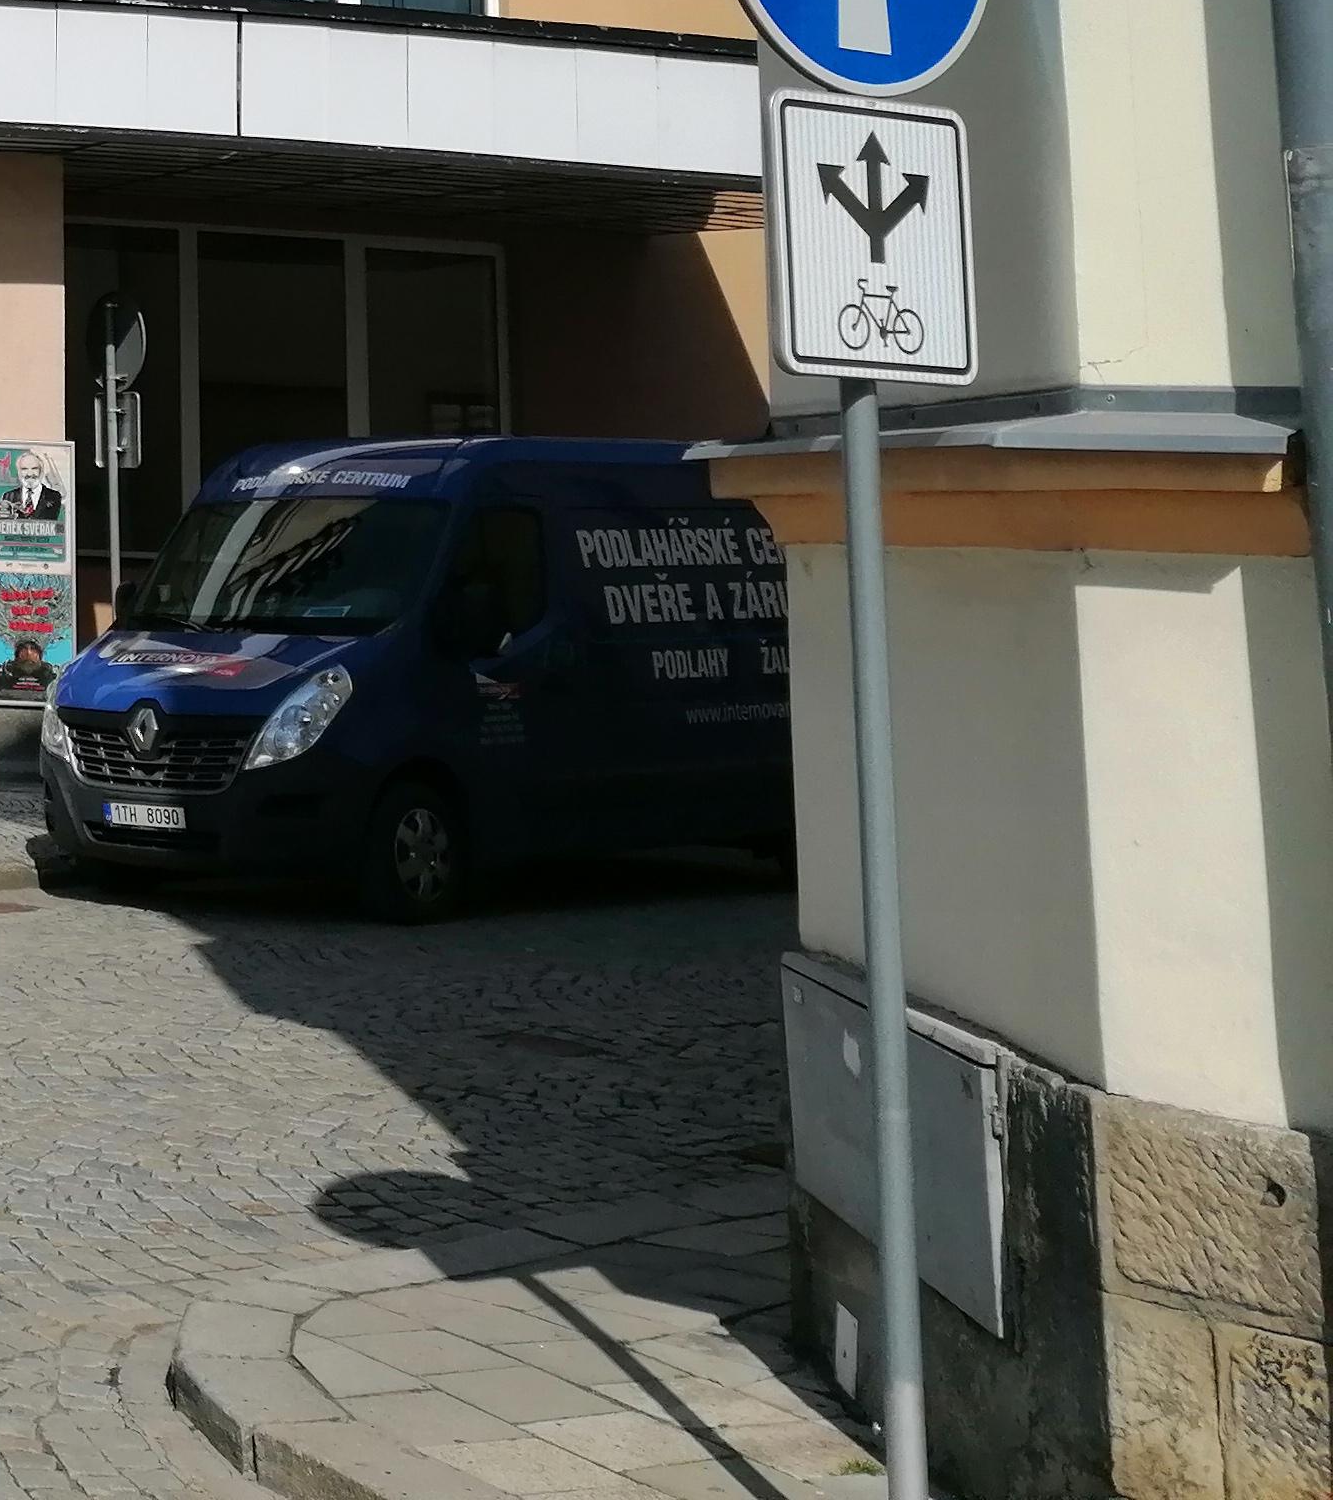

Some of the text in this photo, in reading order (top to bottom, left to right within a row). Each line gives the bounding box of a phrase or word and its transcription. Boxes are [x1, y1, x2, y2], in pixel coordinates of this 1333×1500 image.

[332, 470, 412, 489] CENTRUM
[575, 517, 743, 569] PODLAHÁŘSKÉ
[603, 573, 696, 624] DVEŘE
[705, 583, 725, 620] A
[651, 649, 729, 680] PODLAHY
[115, 804, 179, 826] 1TH 8090
